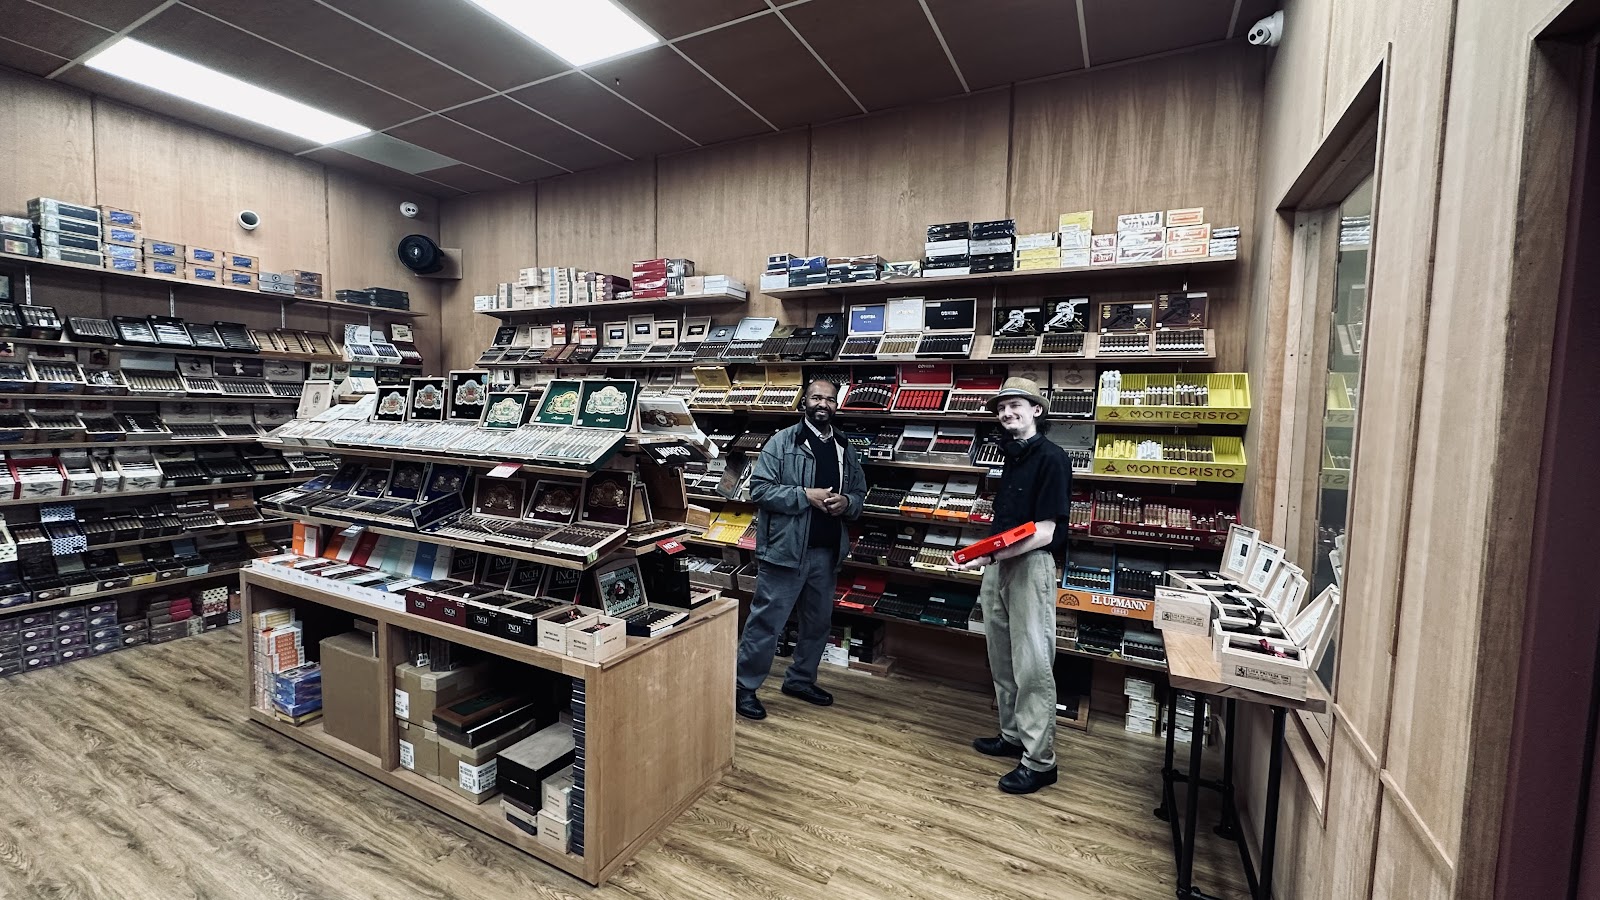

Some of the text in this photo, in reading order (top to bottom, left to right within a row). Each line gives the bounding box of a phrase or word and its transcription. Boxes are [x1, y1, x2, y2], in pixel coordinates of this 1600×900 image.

[1130, 410, 1240, 420] MONTECRISTO
[655, 446, 691, 458] WARPED
[1126, 464, 1236, 478] MONTECRISTO
[1126, 529, 1156, 537] ROMEO
[1166, 533, 1201, 541] JULIETA
[662, 541, 679, 550] NEW
[520, 569, 539, 580] INCH
[555, 569, 580, 581] INCH
